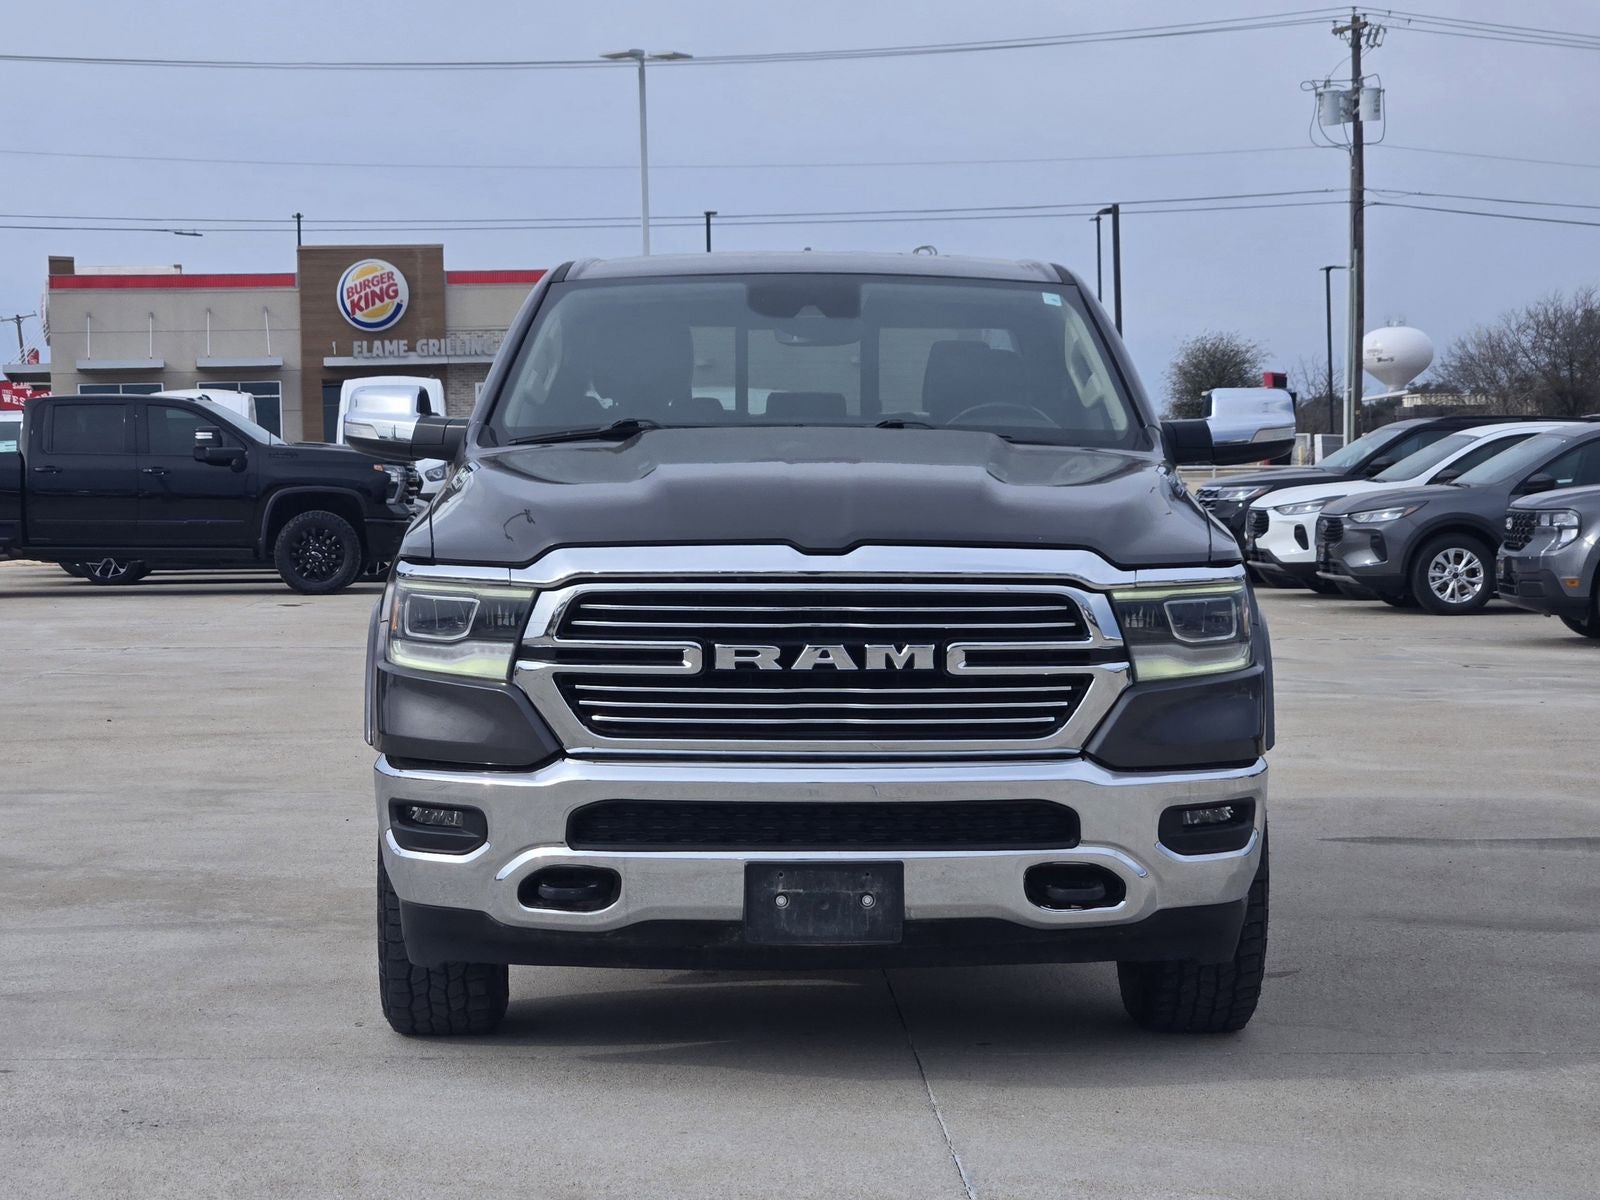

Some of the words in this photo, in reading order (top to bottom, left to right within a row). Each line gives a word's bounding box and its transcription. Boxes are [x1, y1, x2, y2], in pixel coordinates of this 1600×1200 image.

[346, 271, 395, 300] BURGER
[350, 283, 399, 316] KING
[353, 339, 408, 358] FLAME
[416, 338, 498, 356] GRILLING
[714, 643, 935, 670] RAM
